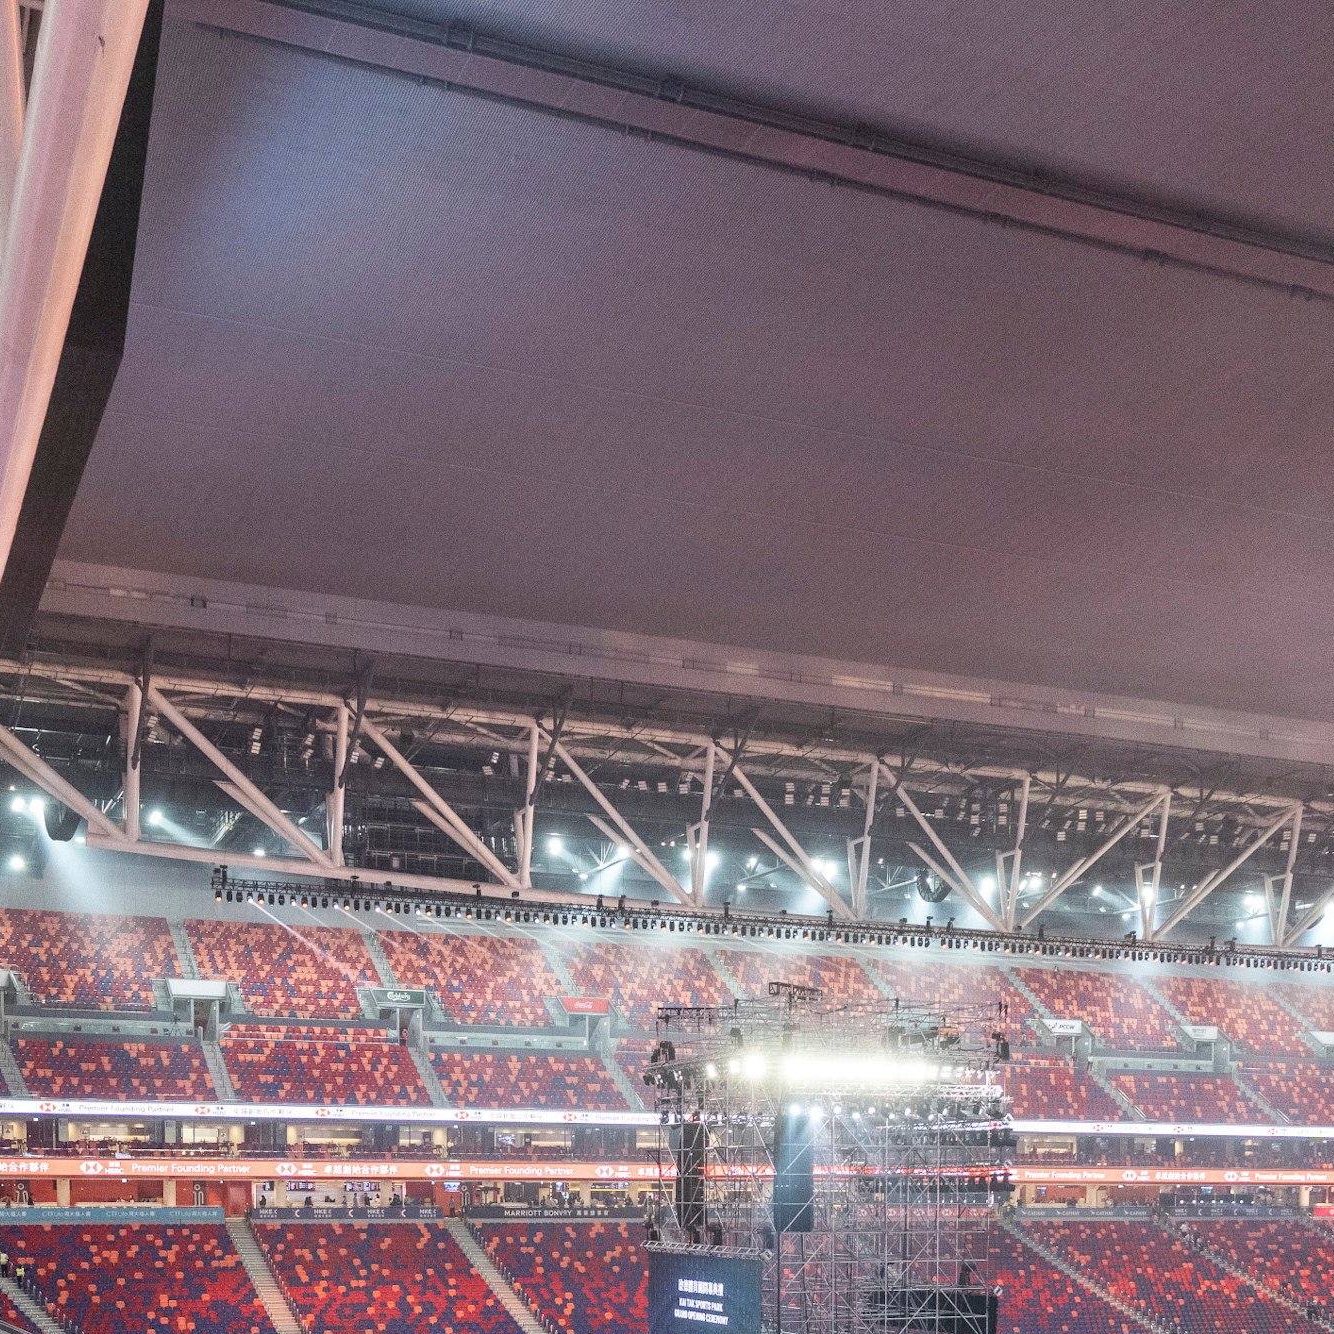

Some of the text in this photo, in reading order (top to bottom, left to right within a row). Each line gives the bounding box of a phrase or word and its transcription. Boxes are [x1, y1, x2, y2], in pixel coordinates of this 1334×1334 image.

[131, 1163, 251, 1175] Premier Founding Partner
[469, 1166, 575, 1178] Premier Founding Partner
[1025, 1171, 1106, 1181] Premier Founding Partner
[687, 1299, 695, 1308] TAK
[695, 1300, 712, 1310] SPORTS
[712, 1302, 723, 1312] PARK
[674, 1309, 728, 1325] GRAND OPENING CEREMONY
